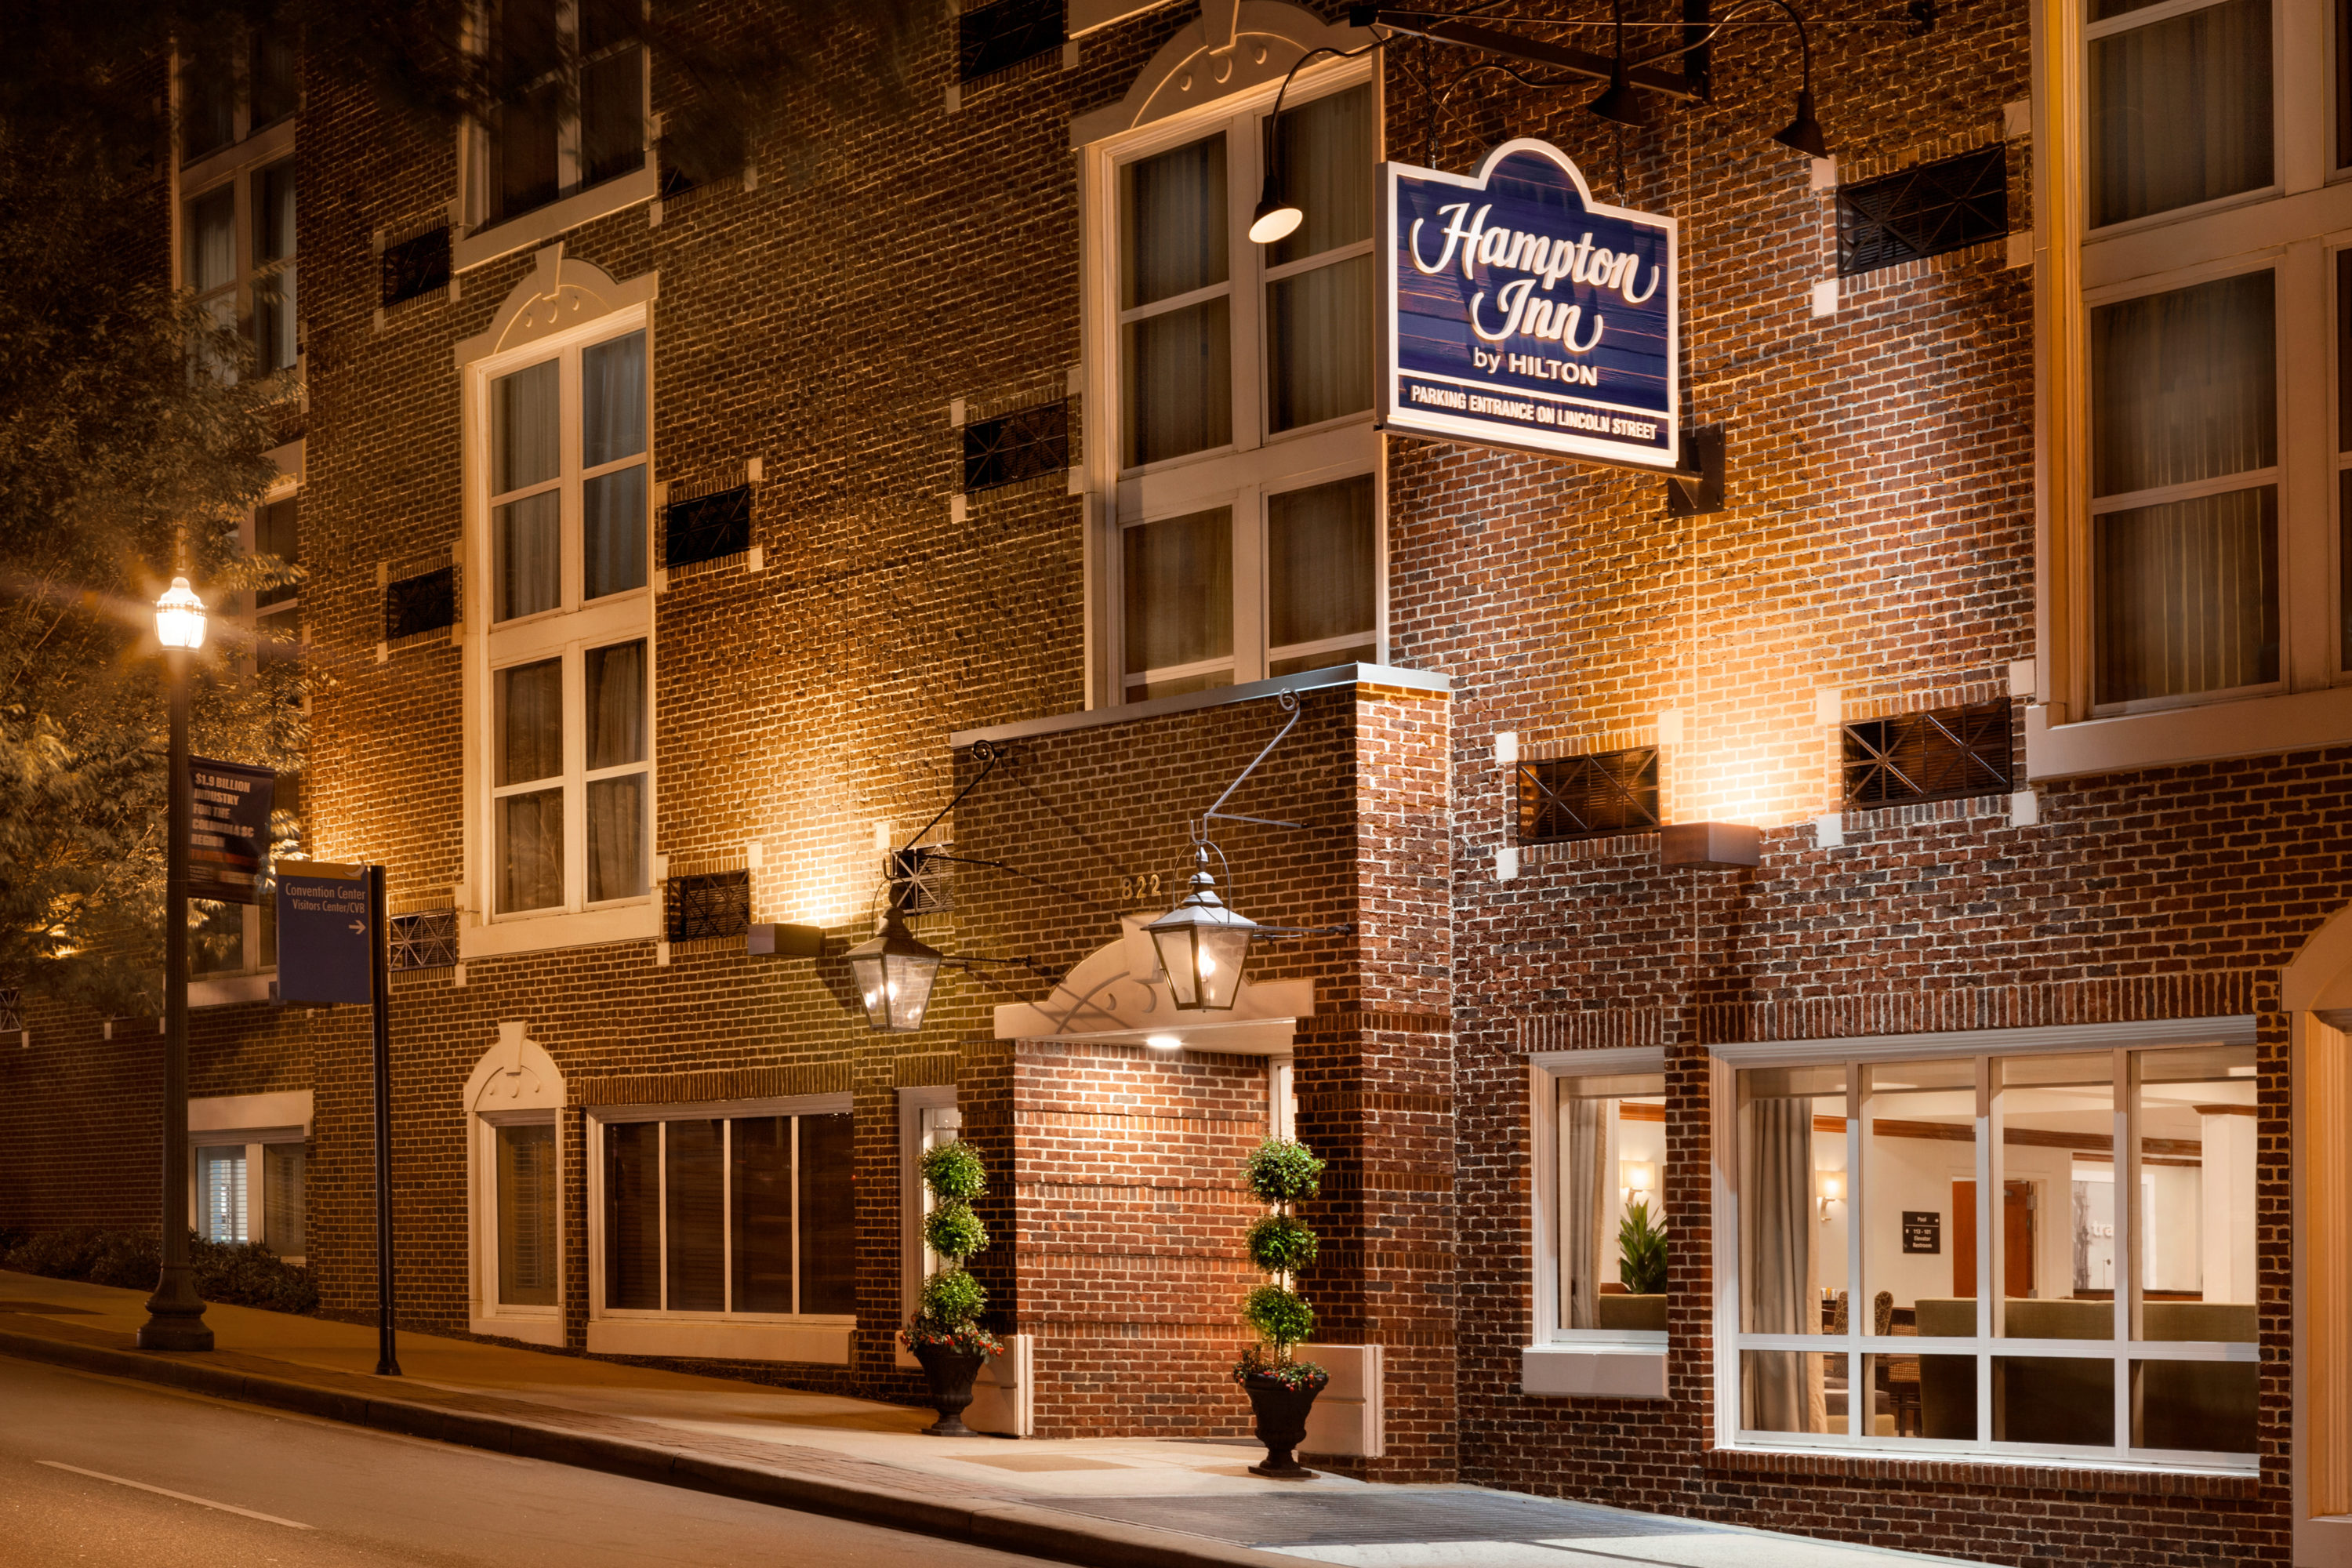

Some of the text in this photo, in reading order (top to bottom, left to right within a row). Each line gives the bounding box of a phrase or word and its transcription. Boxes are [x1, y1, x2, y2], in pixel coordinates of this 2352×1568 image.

[1410, 203, 1659, 303] Hampton
[1470, 279, 1603, 352] Inn
[1473, 347, 1599, 386] by HILTON
[1411, 385, 1657, 440] PARKING ENTRANCE ON LINCOLN STREET
[195, 773, 250, 793] $1.9 BILLION
[194, 788, 240, 806] INDUSTRY
[193, 803, 230, 818] FOR THE
[285, 883, 365, 900] Convention Center
[1122, 874, 1161, 900] 822
[292, 898, 365, 913] Visitors Center/CVB
